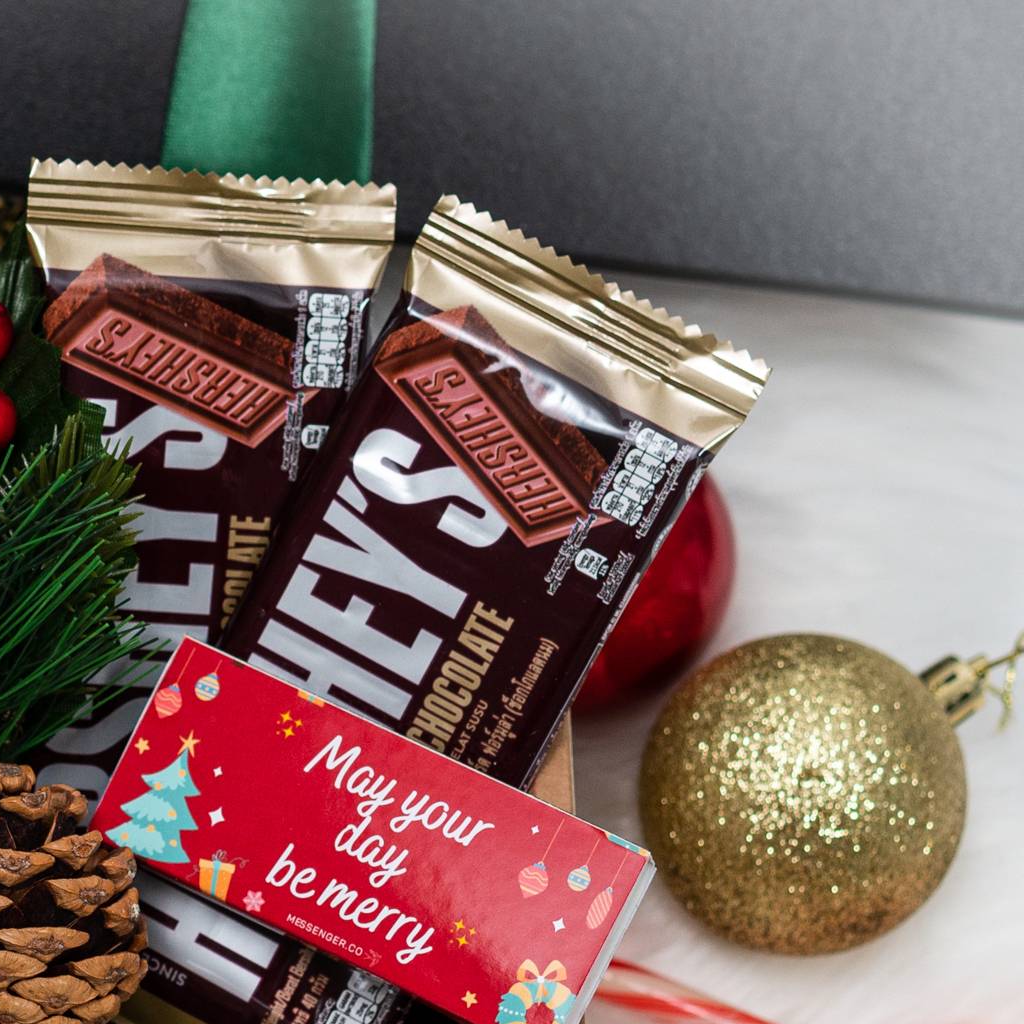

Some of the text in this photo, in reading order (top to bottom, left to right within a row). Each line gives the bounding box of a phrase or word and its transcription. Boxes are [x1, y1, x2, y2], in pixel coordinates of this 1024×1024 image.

[86, 317, 279, 424] HERSHEY'S
[414, 367, 574, 525] HERSHEY'S
[406, 601, 515, 753] CHOCOLATE
[464, 699, 490, 733] SUSU
[304, 735, 494, 847] May your
[265, 845, 435, 964] be merry
[335, 820, 408, 888] day
[286, 913, 364, 957] MESSENGER.CO
[301, 993, 319, 1008] 40
